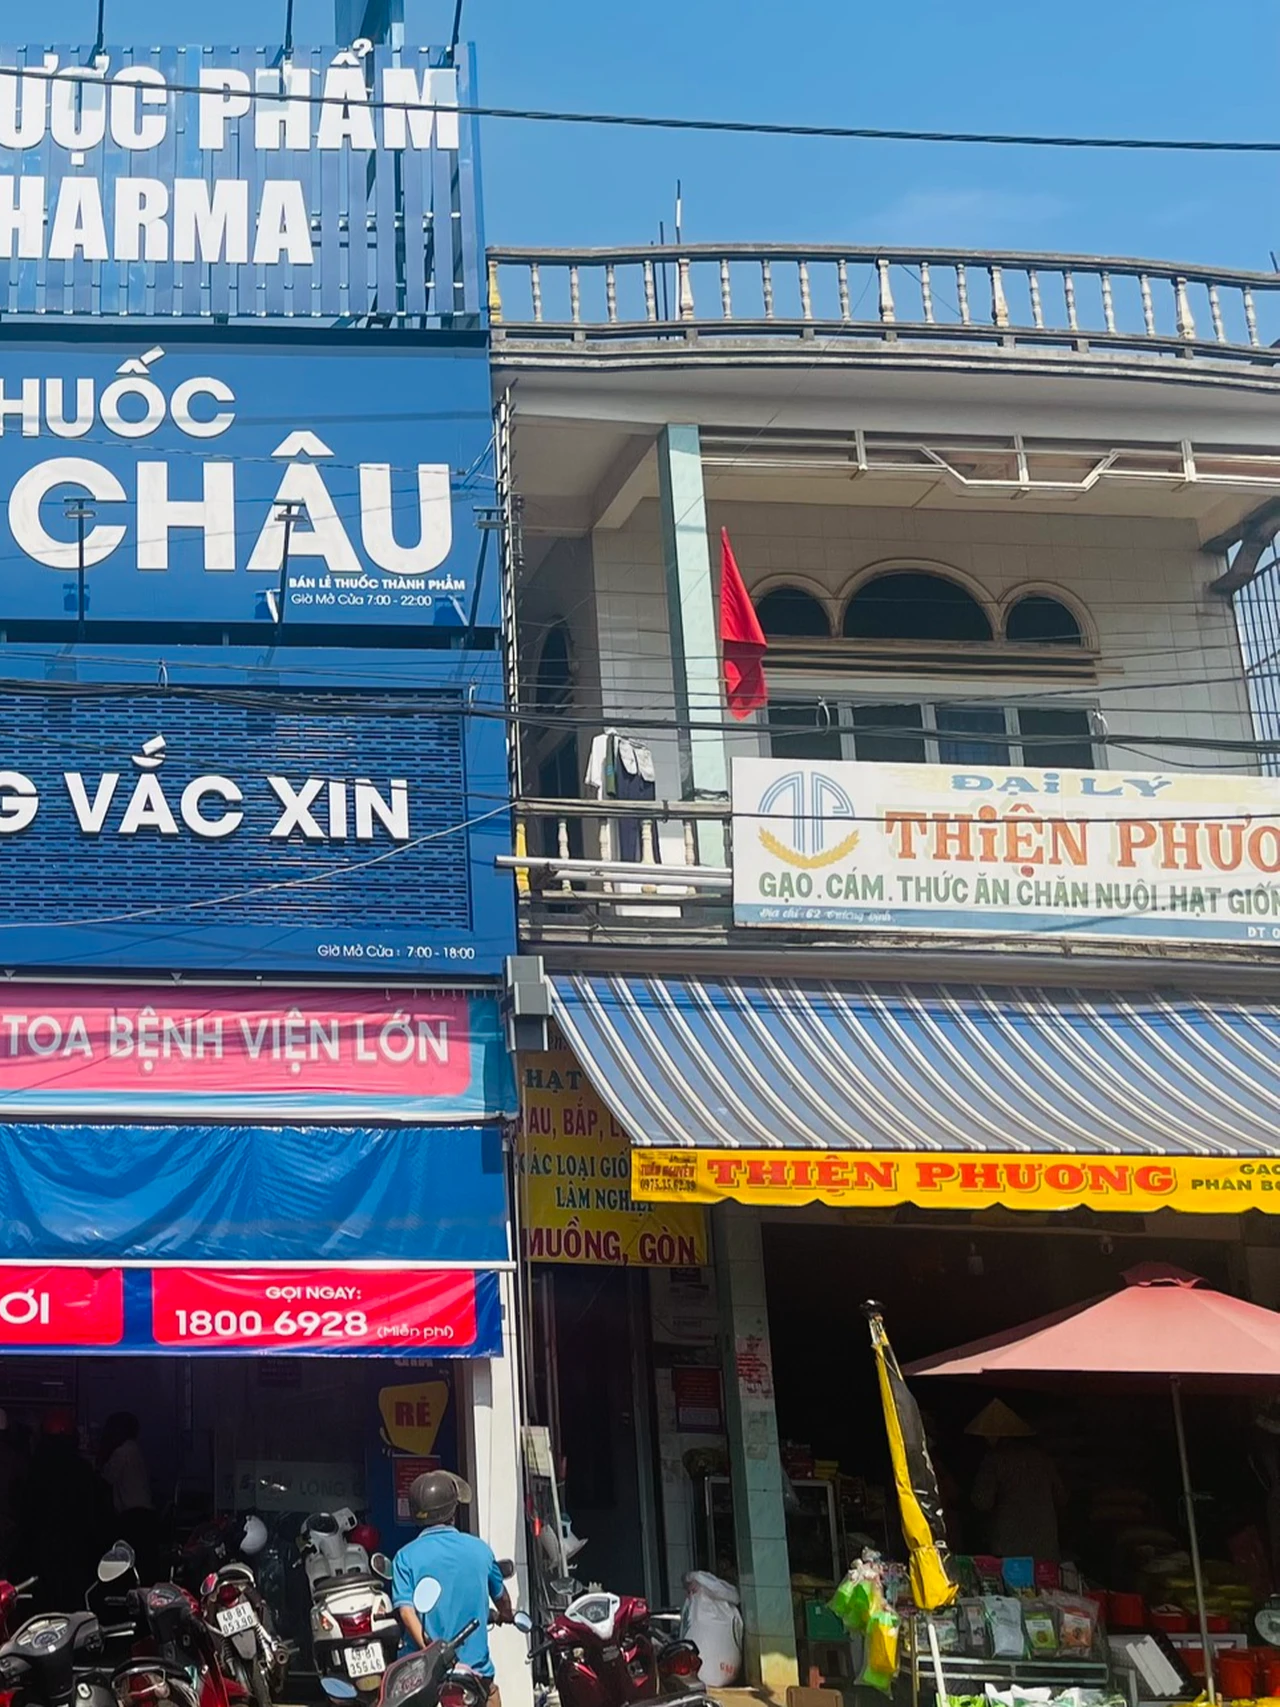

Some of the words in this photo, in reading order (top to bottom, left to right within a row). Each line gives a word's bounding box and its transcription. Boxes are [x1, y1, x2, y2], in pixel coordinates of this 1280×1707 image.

[198, 38, 459, 151] PHẨM
[7, 431, 452, 575] CHÂU
[289, 576, 315, 589] BÁN
[335, 573, 379, 589] THUỐC
[382, 575, 424, 590] THÀNH
[429, 574, 465, 590] PHẨM
[291, 592, 313, 606] Giờ
[316, 592, 335, 606] Mở
[337, 593, 364, 606] Cửa
[367, 594, 391, 607] 7:00
[400, 594, 432, 607] 22:00
[63, 733, 243, 838] VẮC
[269, 778, 410, 842] XIN
[1080, 775, 1172, 797] LÝ
[896, 869, 969, 904] THỨC
[974, 873, 1010, 905] ĂN
[1016, 875, 1088, 909] CHĂN
[806, 908, 821, 919] 62
[317, 944, 340, 957] Giờ
[343, 943, 364, 957] Mở
[366, 944, 394, 958] Cửa
[407, 946, 432, 959] 7:00
[443, 946, 475, 960] 18:00
[2, 1014, 94, 1058] TOA
[109, 1005, 223, 1073] BỆNH
[240, 1008, 340, 1074] VIỆN
[356, 1009, 448, 1063] LỚN
[526, 1069, 582, 1094] HẠT
[557, 1155, 596, 1181] LOẠI
[707, 1154, 897, 1195] THIỆN
[915, 1161, 1177, 1195] PHƯƠNG
[556, 1181, 590, 1209] LÂM
[523, 1216, 629, 1266] MUỒNG,
[639, 1226, 696, 1265] GÒN
[266, 1286, 302, 1303] GỌI
[306, 1286, 362, 1301] NGAY:
[175, 1309, 262, 1336] 1800
[273, 1310, 368, 1337] 6928
[377, 1324, 420, 1340] (Miễn
[423, 1326, 454, 1340] phí)
